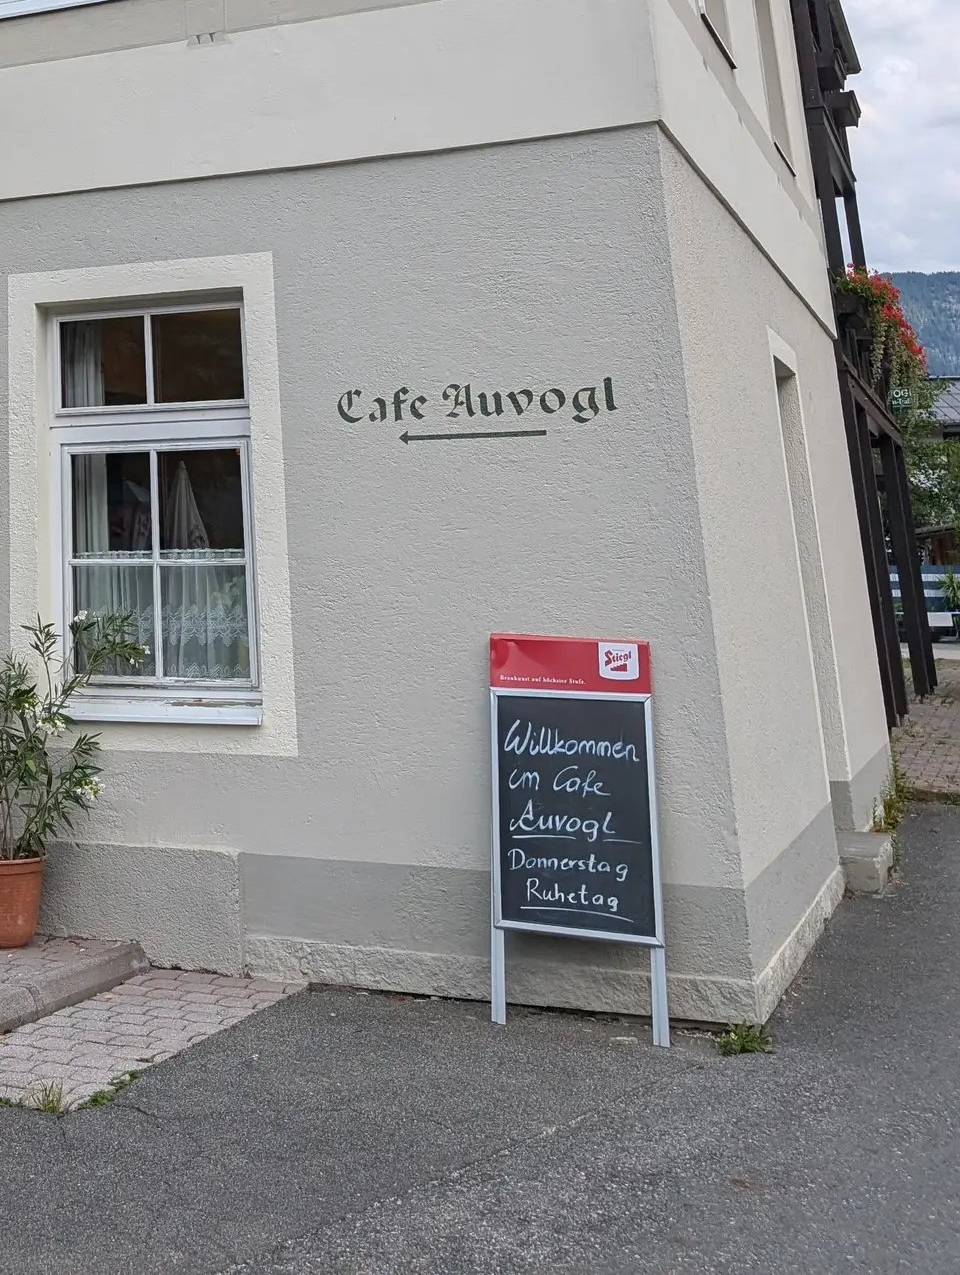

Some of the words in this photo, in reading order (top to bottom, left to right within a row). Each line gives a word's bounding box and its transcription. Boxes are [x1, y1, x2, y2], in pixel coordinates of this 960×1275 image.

[337, 386, 428, 424] Cafe
[442, 376, 618, 424] Auvogl
[604, 649, 632, 667] Stiegl
[504, 719, 640, 762] Willkommen
[553, 765, 611, 798] Cafe
[509, 798, 616, 842] Auvogl
[507, 848, 629, 882] Donnerstag
[526, 877, 619, 912] Ruhetag
